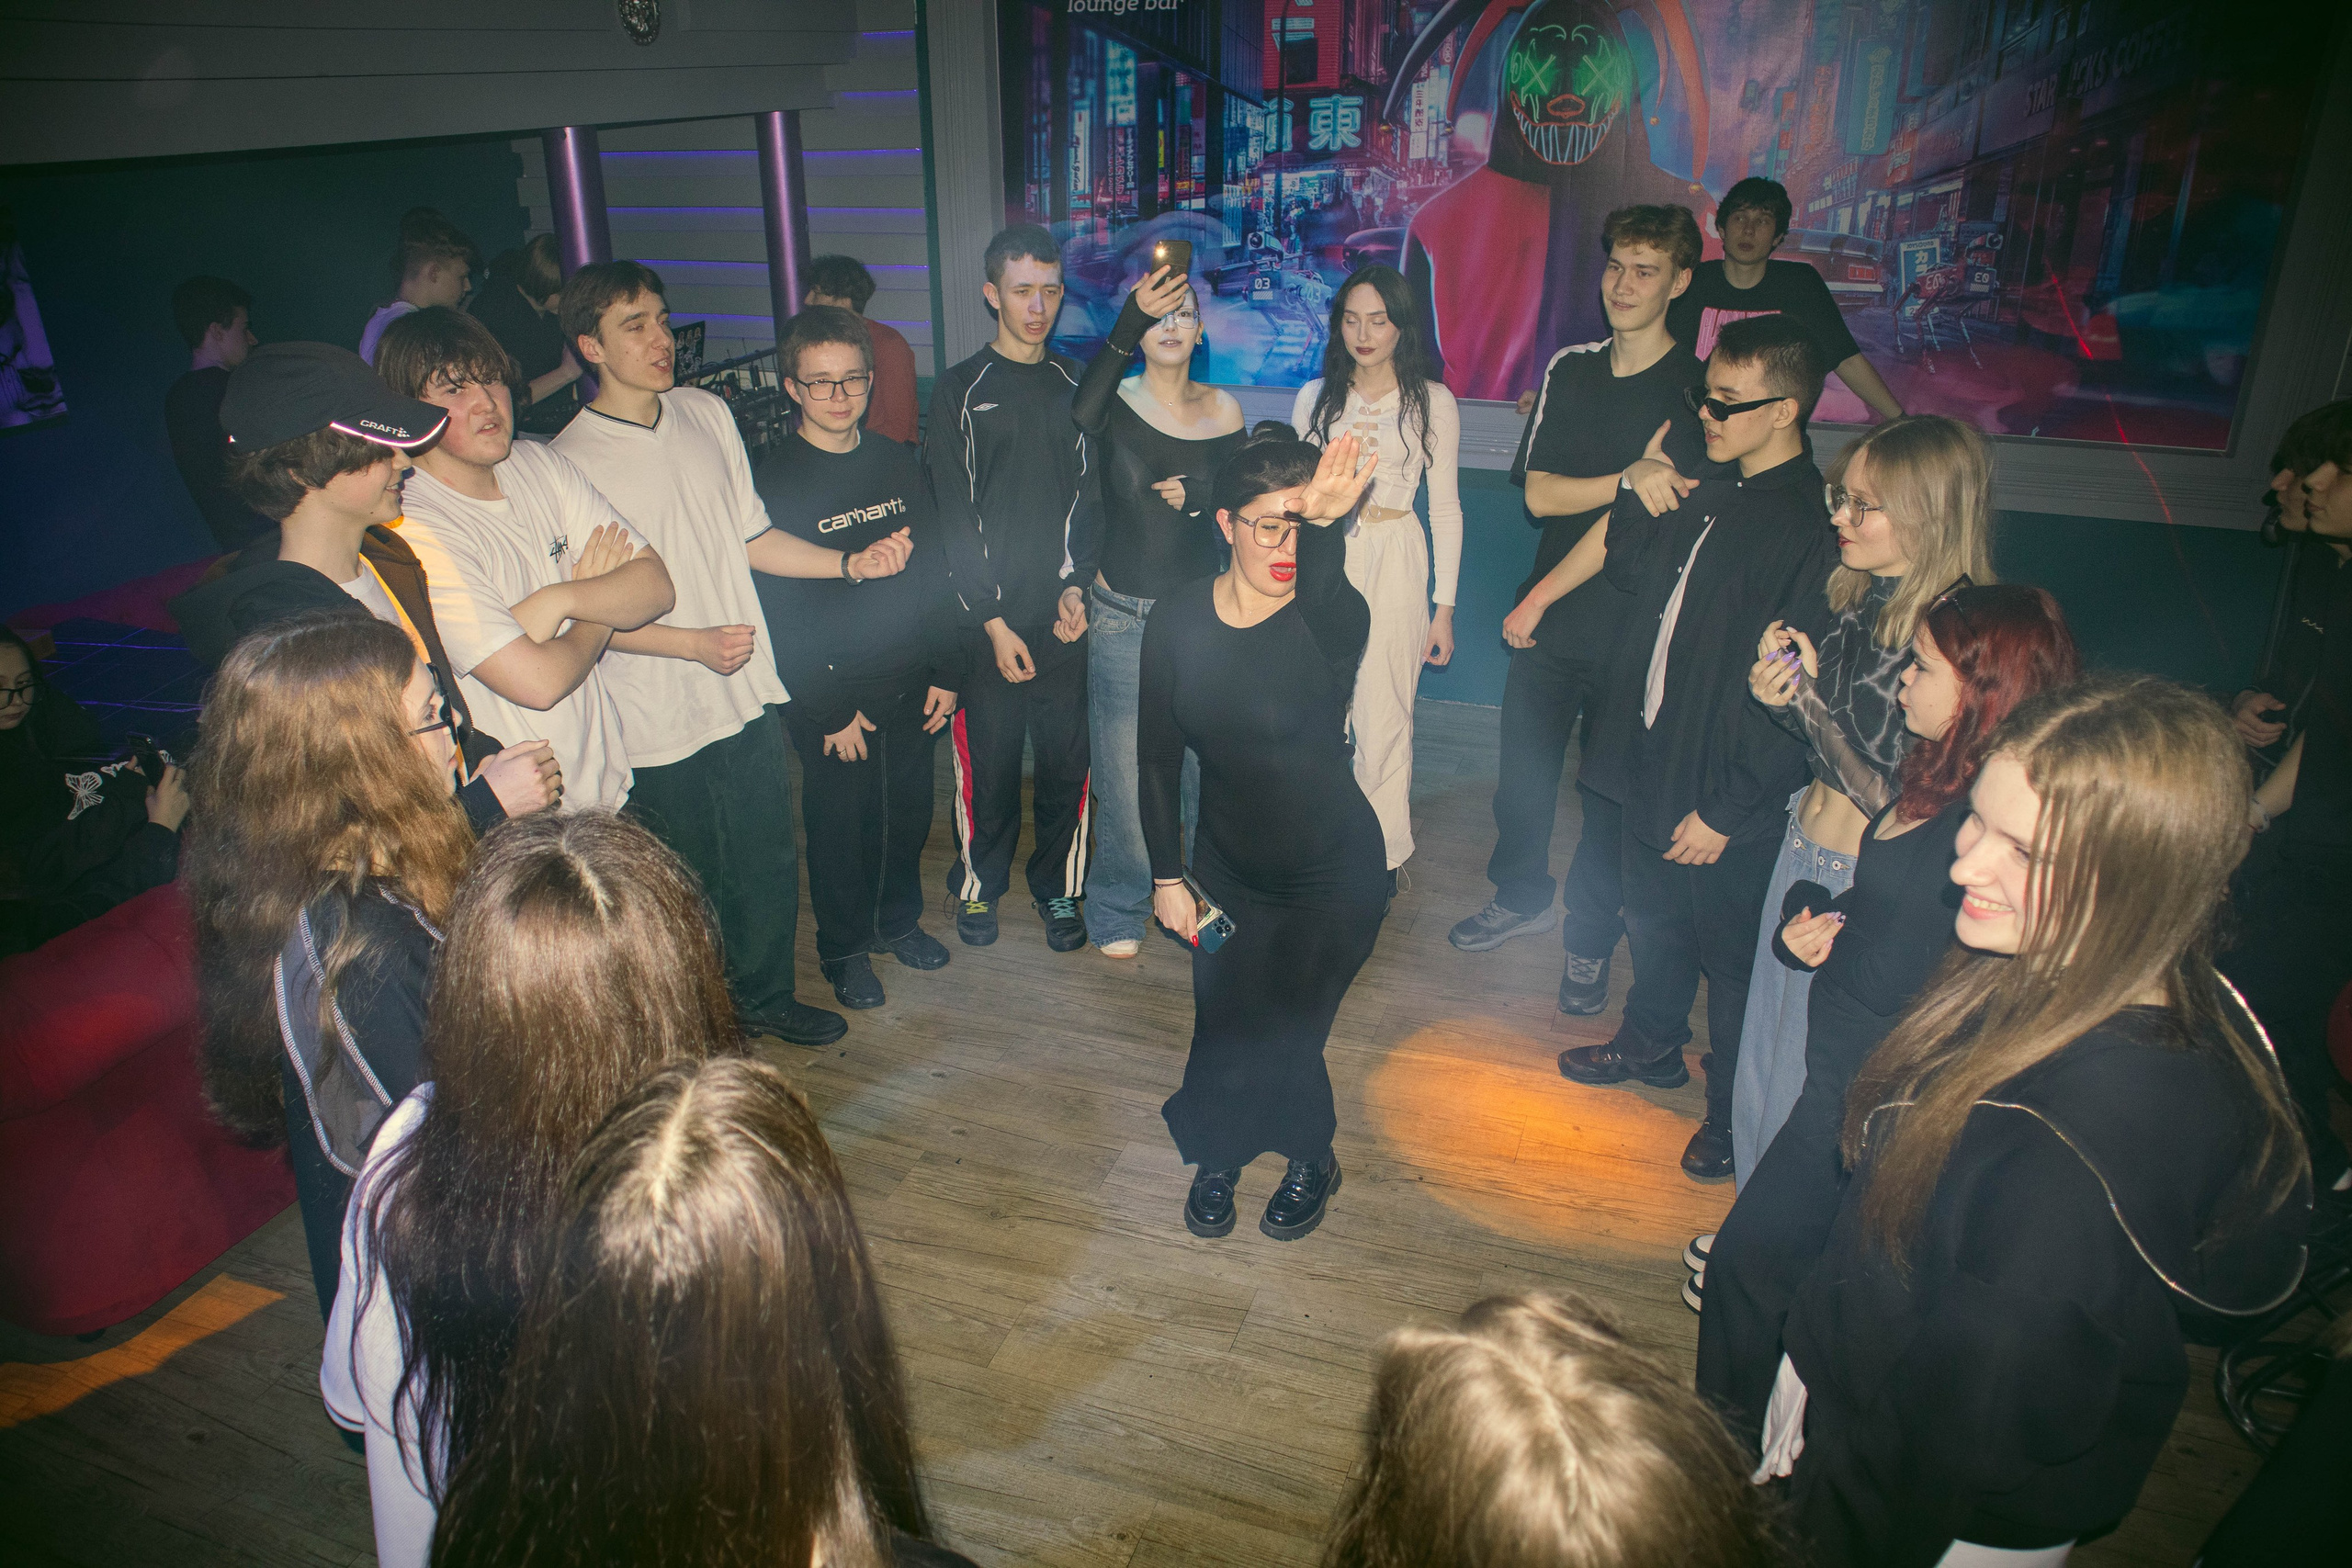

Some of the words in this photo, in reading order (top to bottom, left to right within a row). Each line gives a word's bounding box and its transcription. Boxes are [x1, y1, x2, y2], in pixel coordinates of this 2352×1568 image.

[1067, 0, 1138, 16] lounge
[1145, 0, 1183, 11] bar
[1254, 277, 1271, 290] 03
[359, 419, 399, 435] CRAFT
